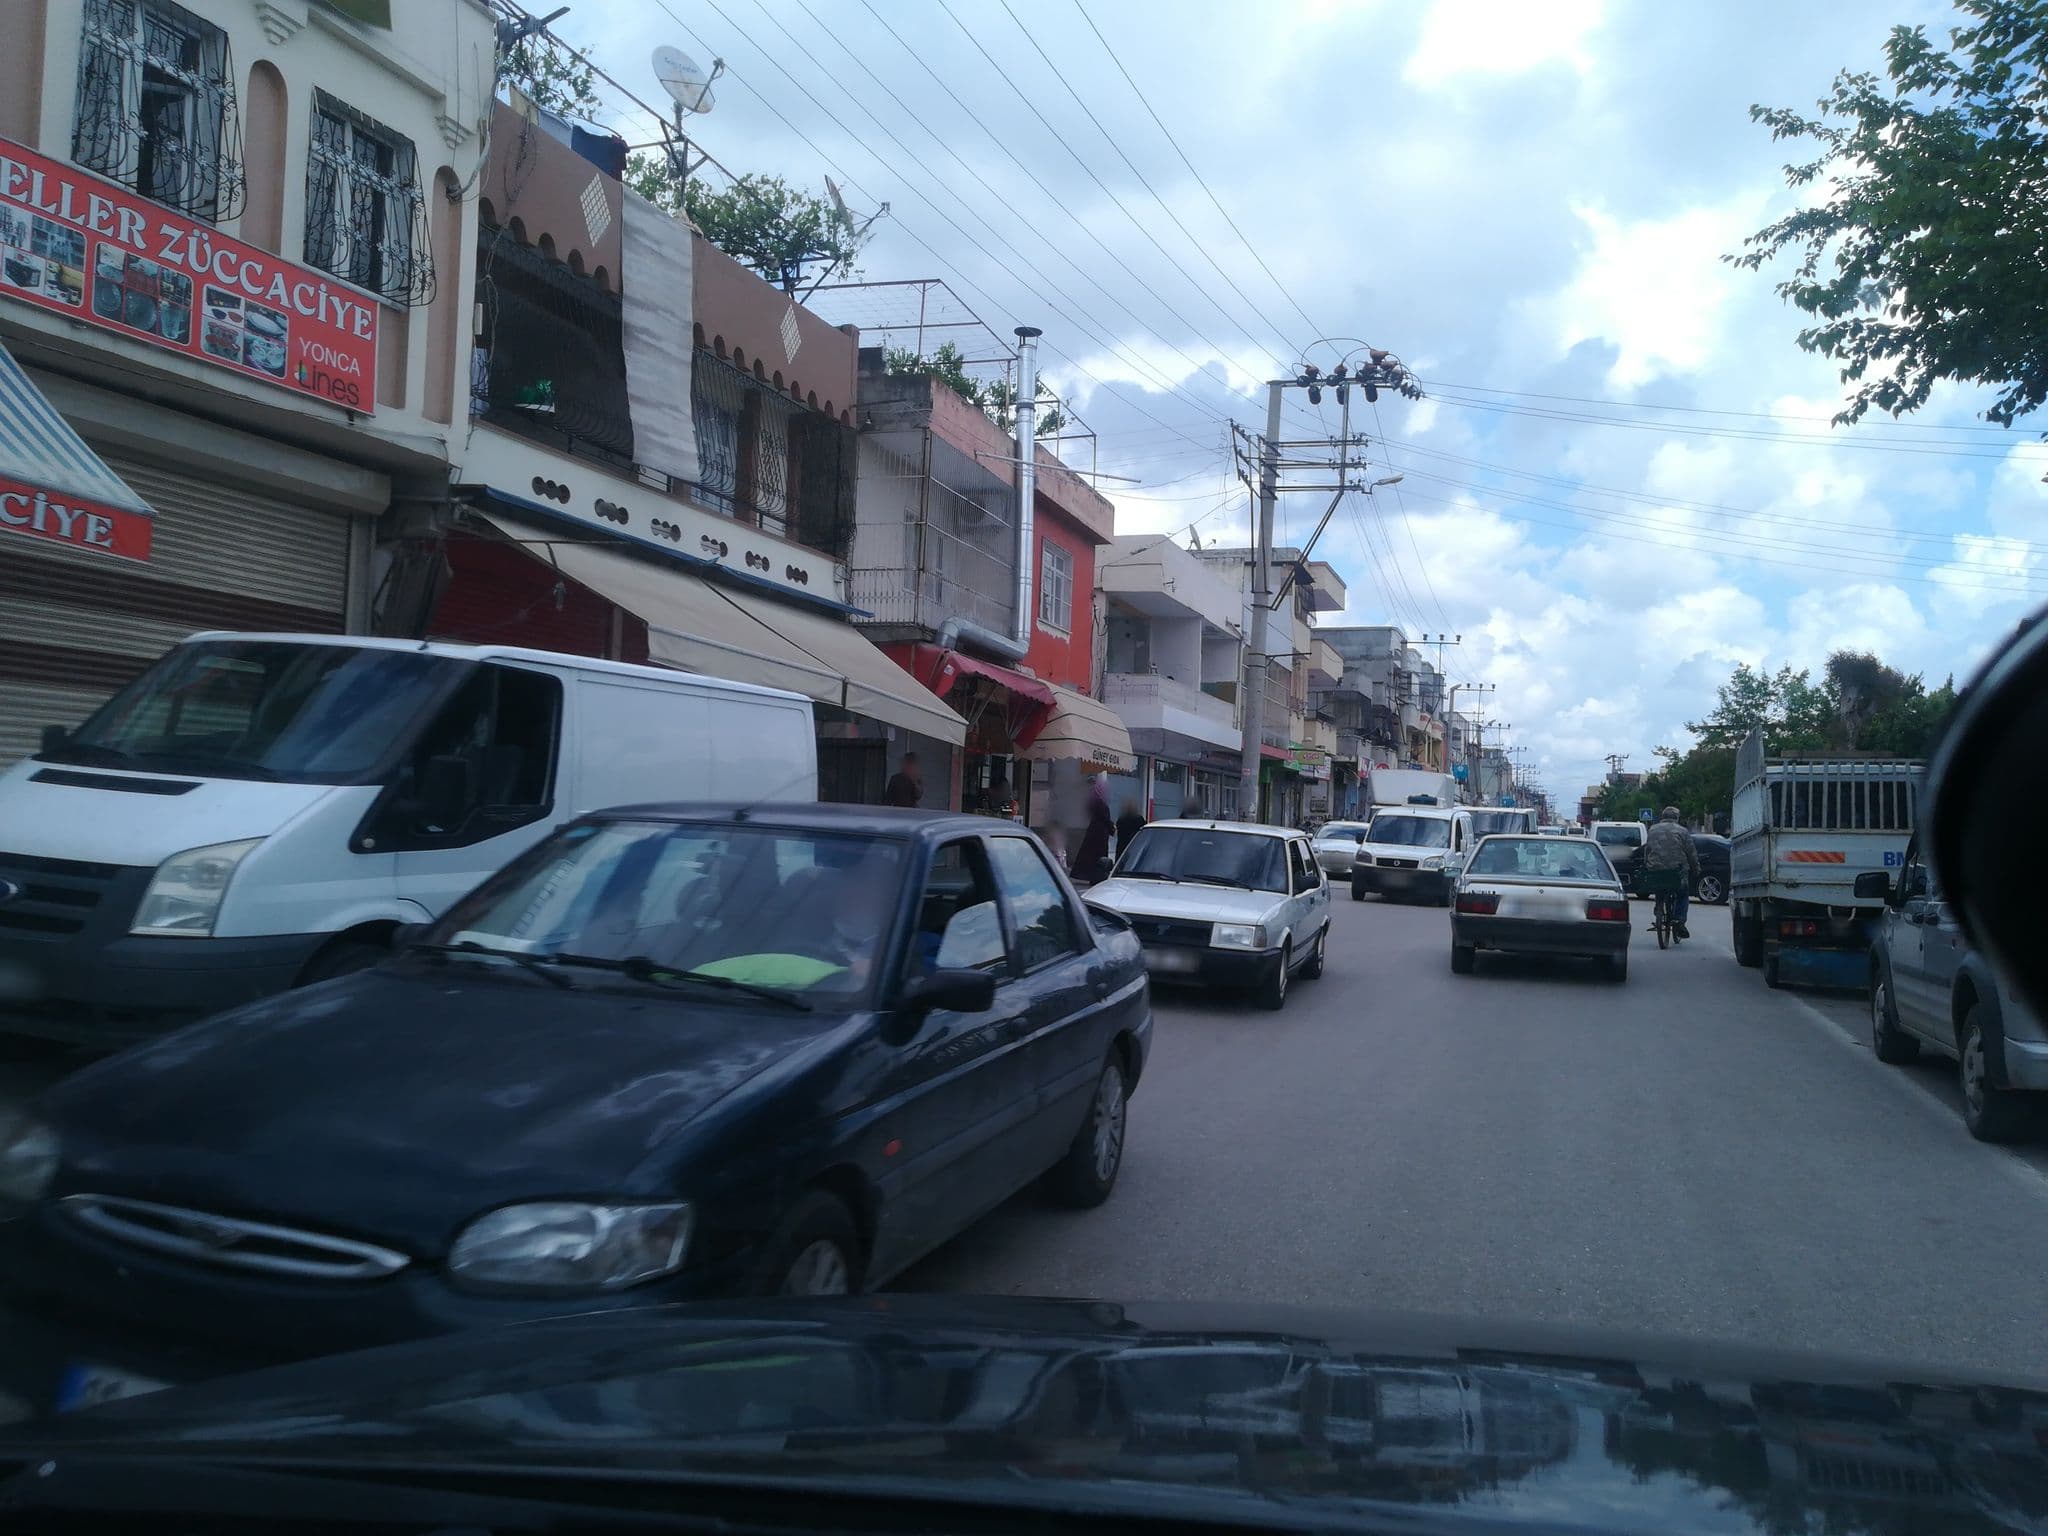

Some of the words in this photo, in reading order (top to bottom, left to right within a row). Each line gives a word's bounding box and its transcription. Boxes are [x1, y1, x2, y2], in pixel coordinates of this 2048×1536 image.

[158, 224, 373, 341] ZÜCCACİYE
[299, 337, 360, 377] YONCA
[0, 492, 113, 548] CİYE
